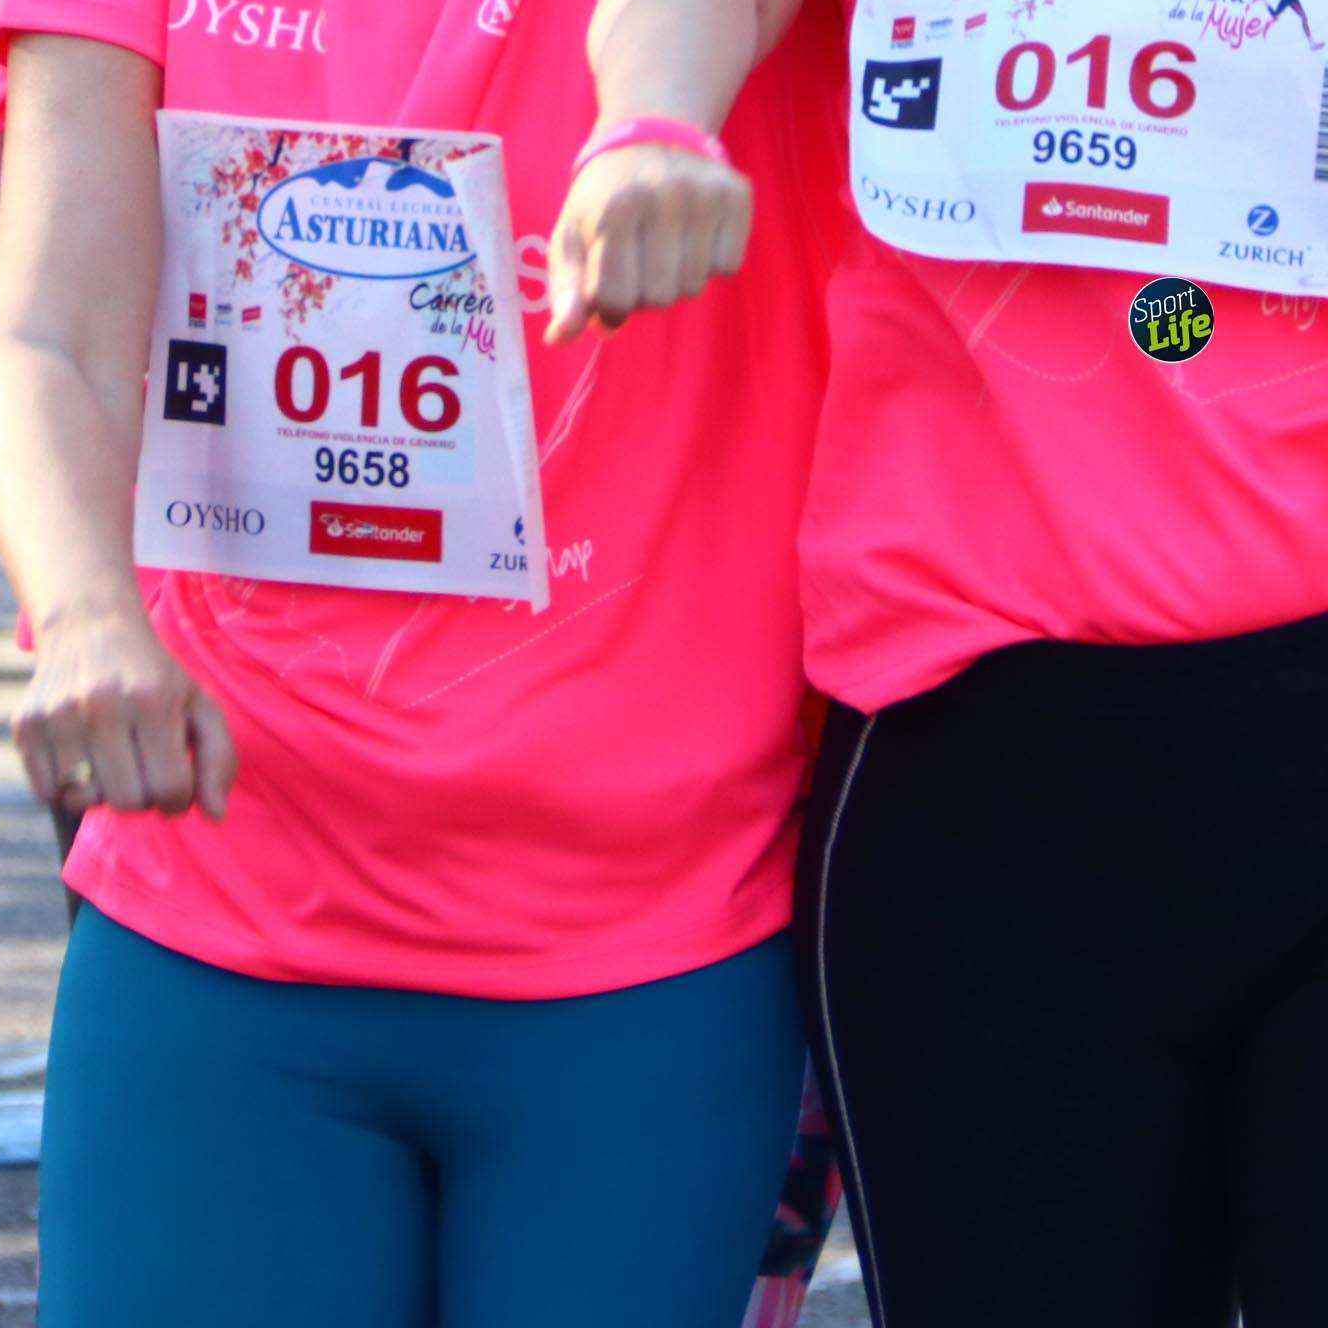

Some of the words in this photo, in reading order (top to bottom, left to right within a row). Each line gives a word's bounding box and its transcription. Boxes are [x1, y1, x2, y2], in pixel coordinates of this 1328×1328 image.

[1169, 7, 1187, 22] de
[1191, 7, 1204, 22] la
[1201, 2, 1280, 50] Mujer
[995, 33, 1198, 119] 016
[1032, 128, 1138, 171] 9659
[311, 196, 382, 212] CENTRAL
[859, 175, 976, 223] OYSHO
[1065, 199, 1151, 228] Santander
[274, 196, 470, 252] ASTURIANA
[1218, 241, 1304, 267] ZURICH
[430, 317, 447, 335] de
[450, 317, 463, 335] la
[273, 344, 462, 434] 016
[315, 446, 410, 488] 9658
[166, 500, 265, 536] OYSHO
